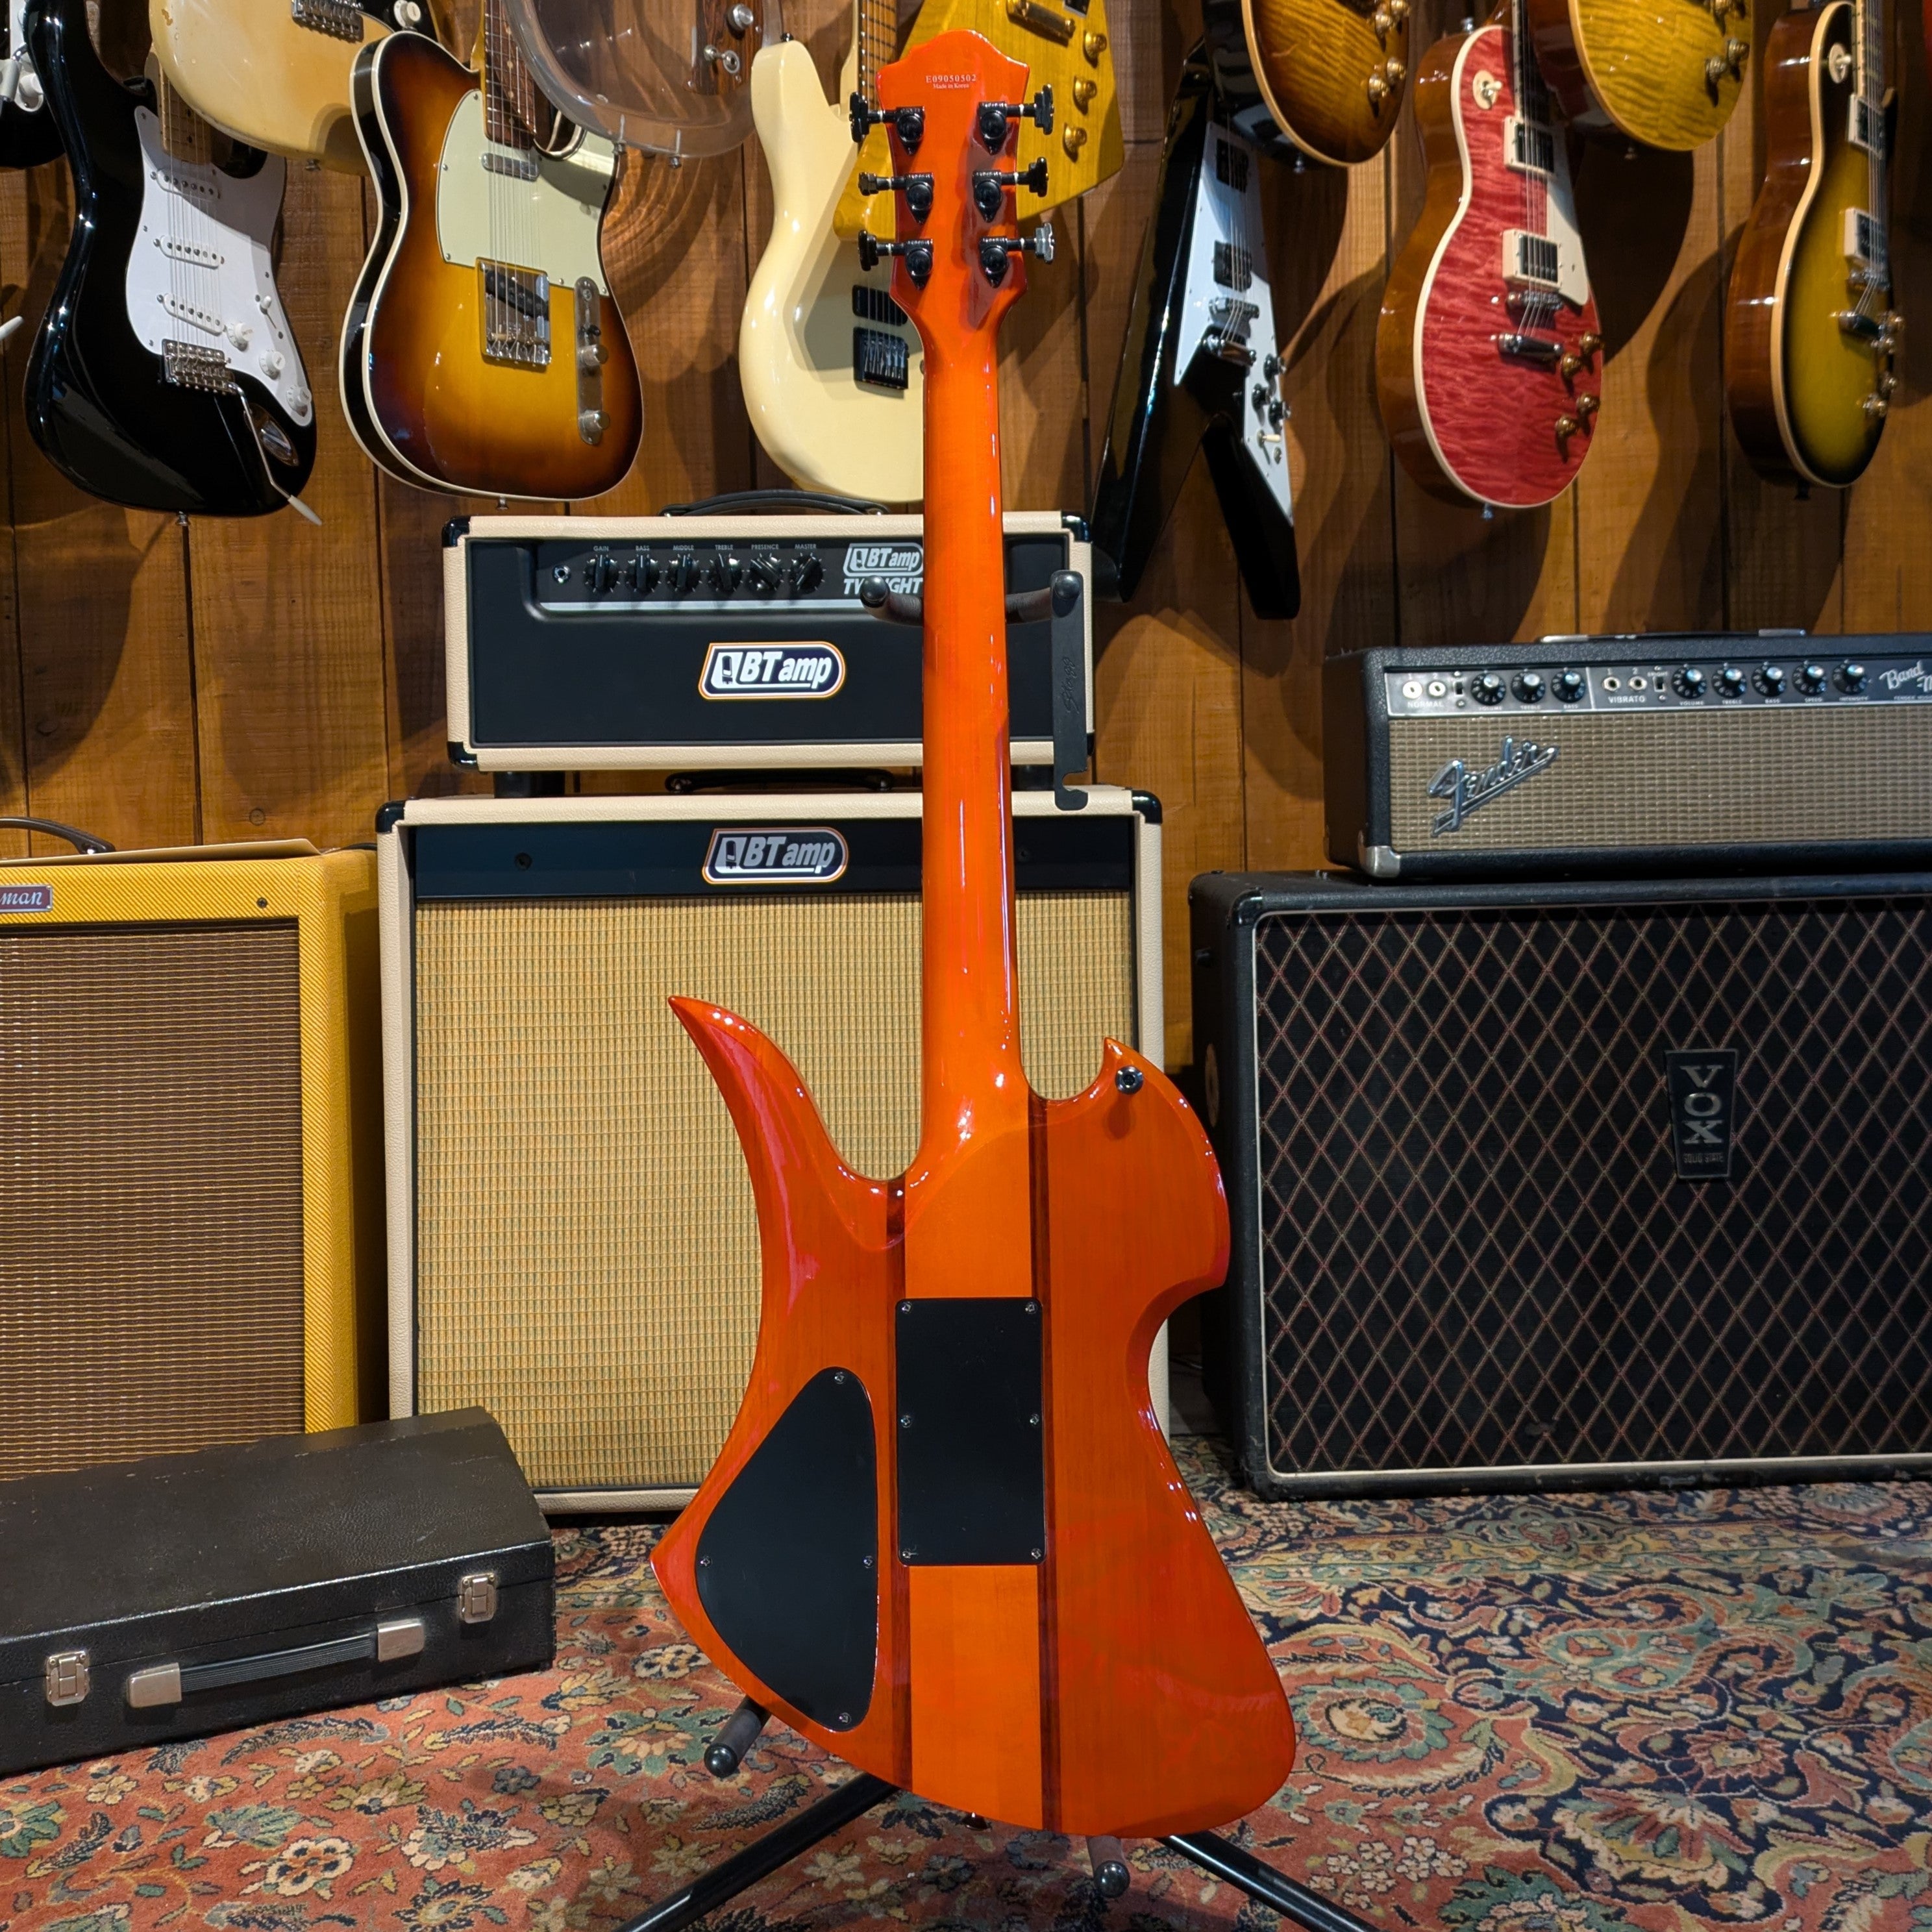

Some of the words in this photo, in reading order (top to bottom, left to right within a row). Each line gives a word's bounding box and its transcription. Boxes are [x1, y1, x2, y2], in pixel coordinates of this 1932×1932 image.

[926, 74, 976, 83] E09050502
[1426, 736, 1559, 838] Fender
[1680, 1065, 1724, 1145] VOX
